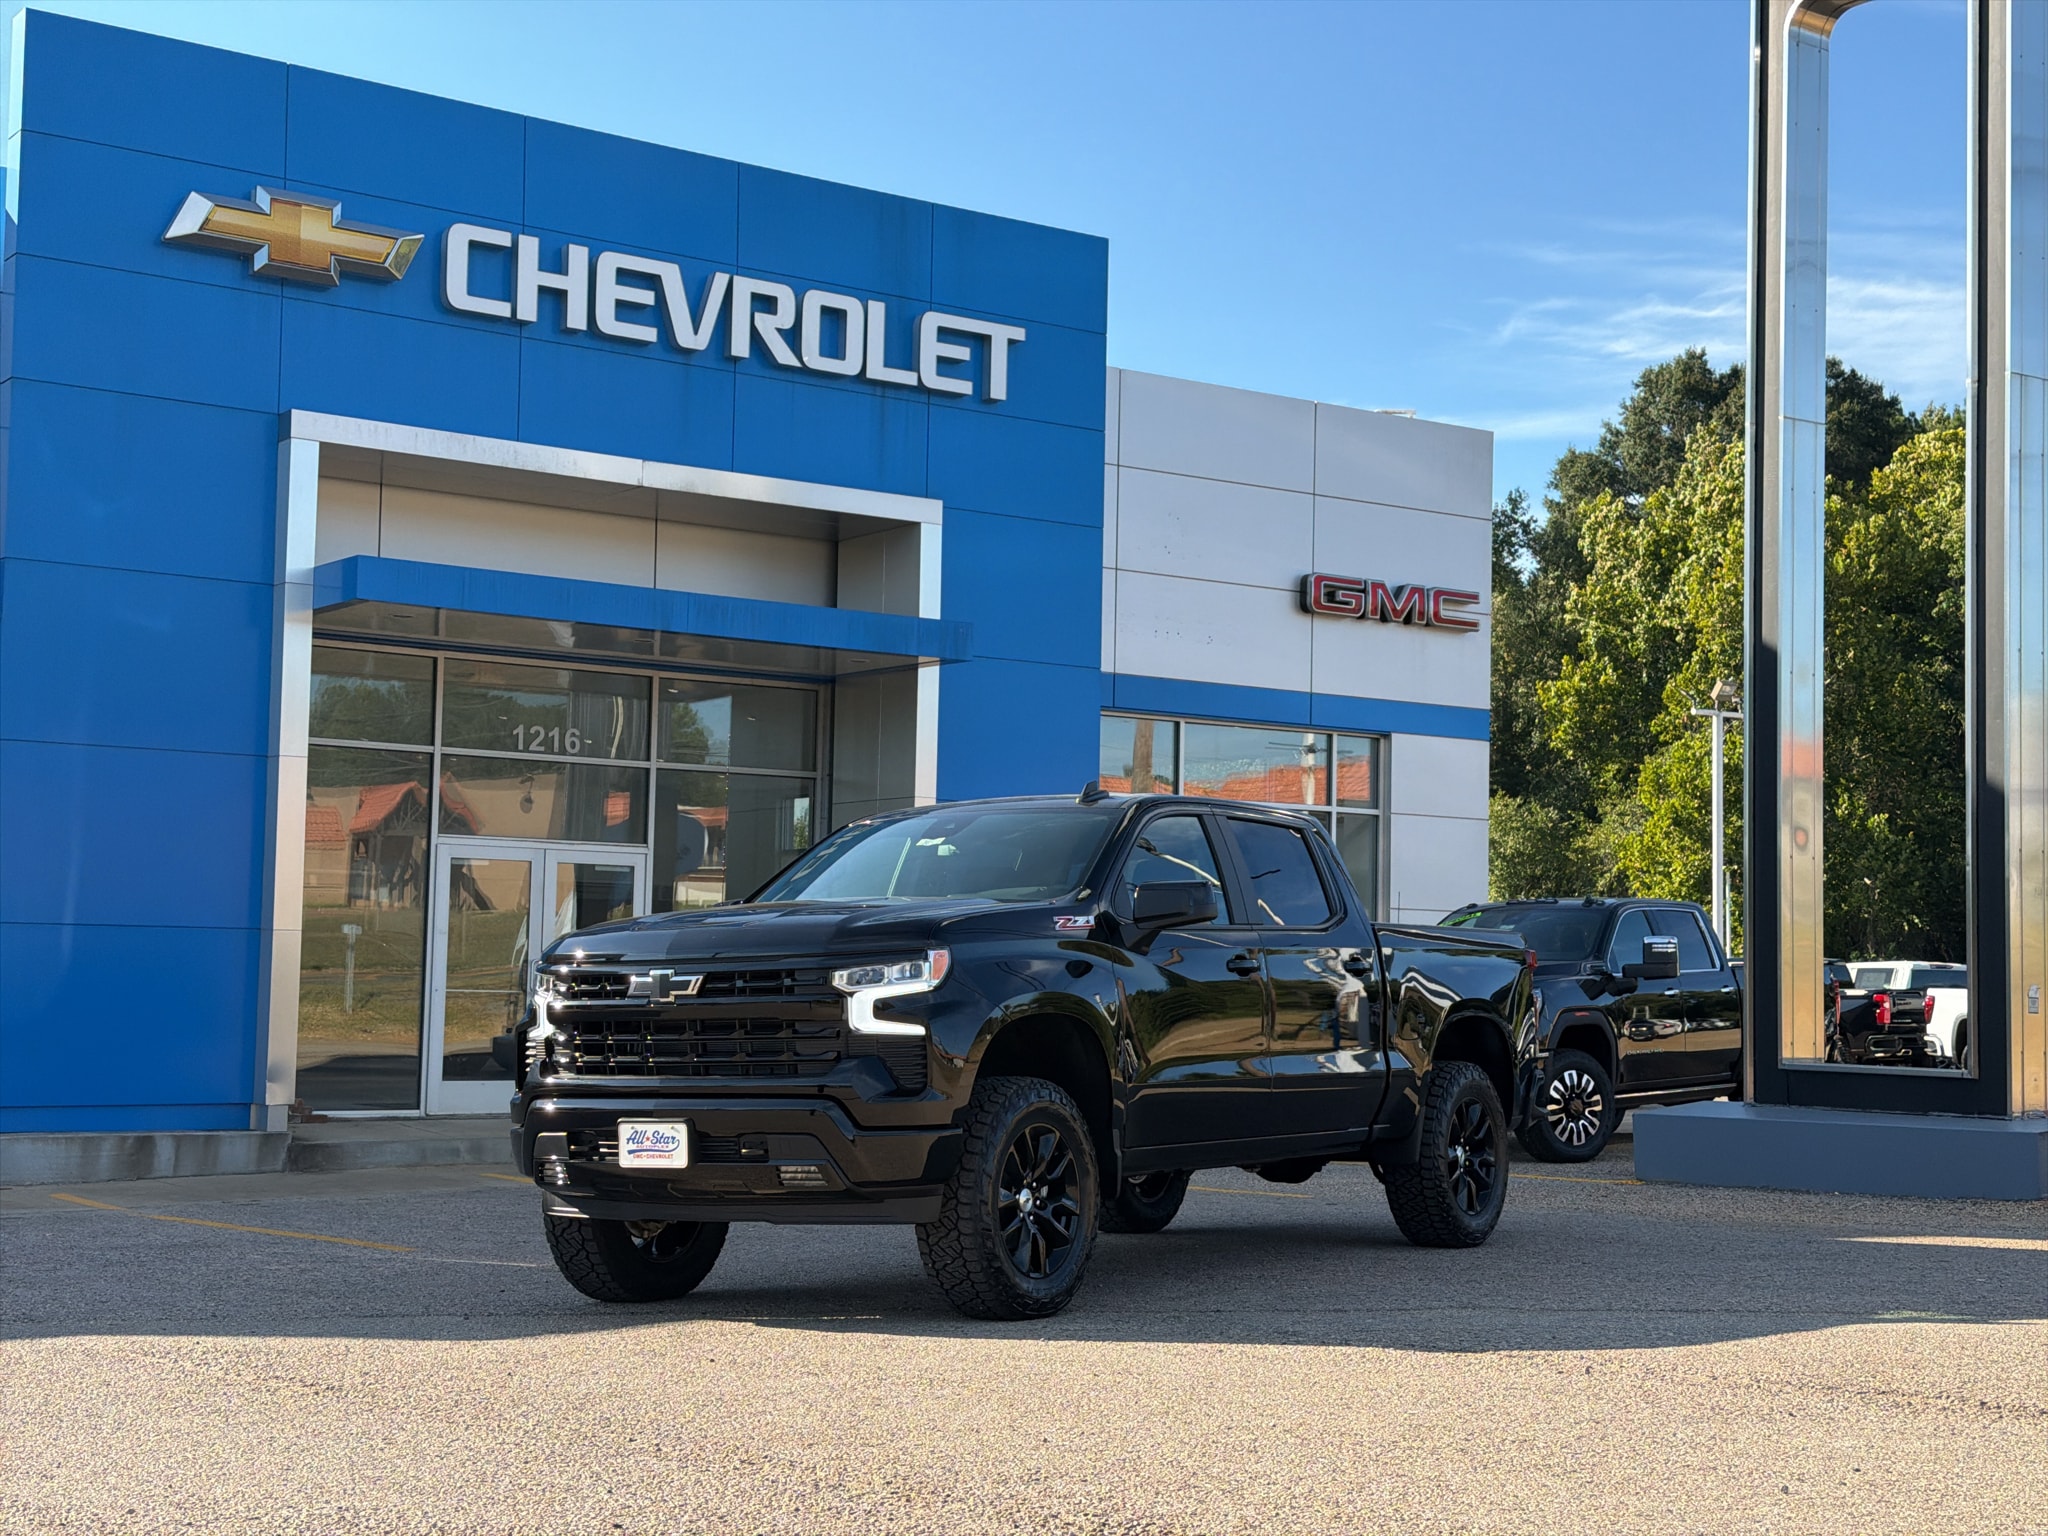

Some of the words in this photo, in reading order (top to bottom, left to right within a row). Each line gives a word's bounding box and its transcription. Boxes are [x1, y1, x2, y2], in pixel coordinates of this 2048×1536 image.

[442, 223, 1027, 401] CHEVROLET
[1301, 573, 1480, 632] GMC
[512, 724, 581, 754] 1216
[626, 1130, 647, 1144] All
[650, 1130, 676, 1144] Star
